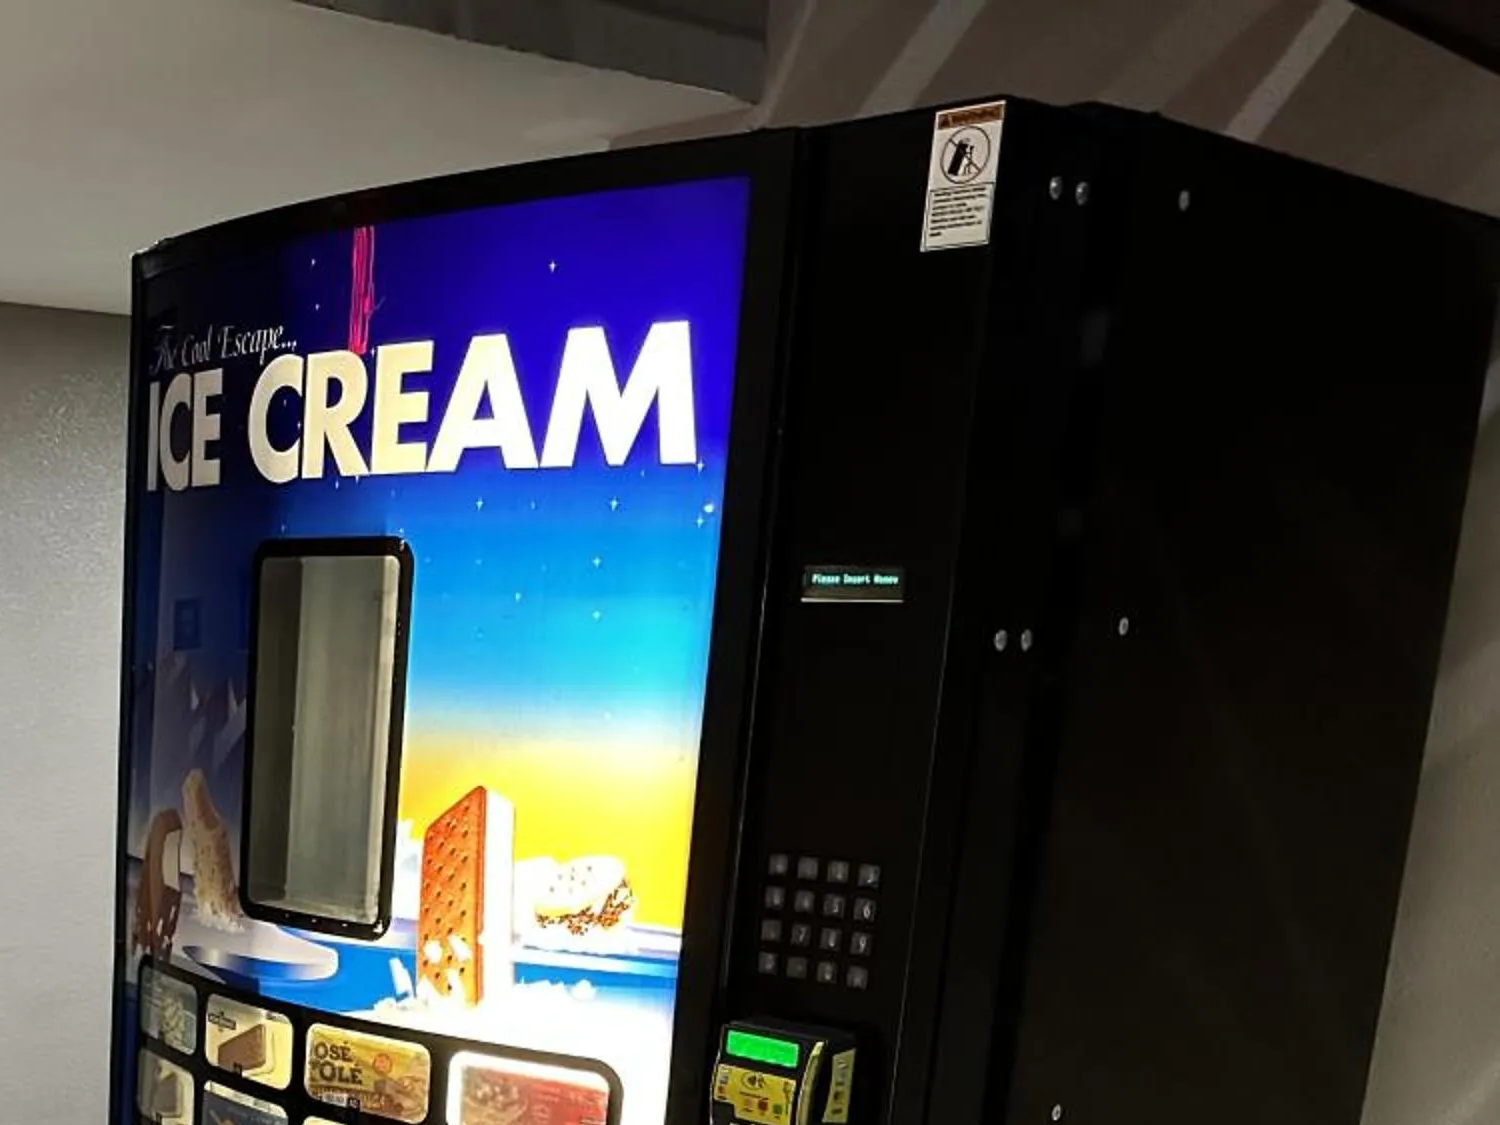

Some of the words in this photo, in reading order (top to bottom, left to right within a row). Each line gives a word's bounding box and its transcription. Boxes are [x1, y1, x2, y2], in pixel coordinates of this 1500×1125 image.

[181, 323, 214, 367] Cool
[147, 368, 223, 492] ICE
[248, 320, 698, 484] CREAM
